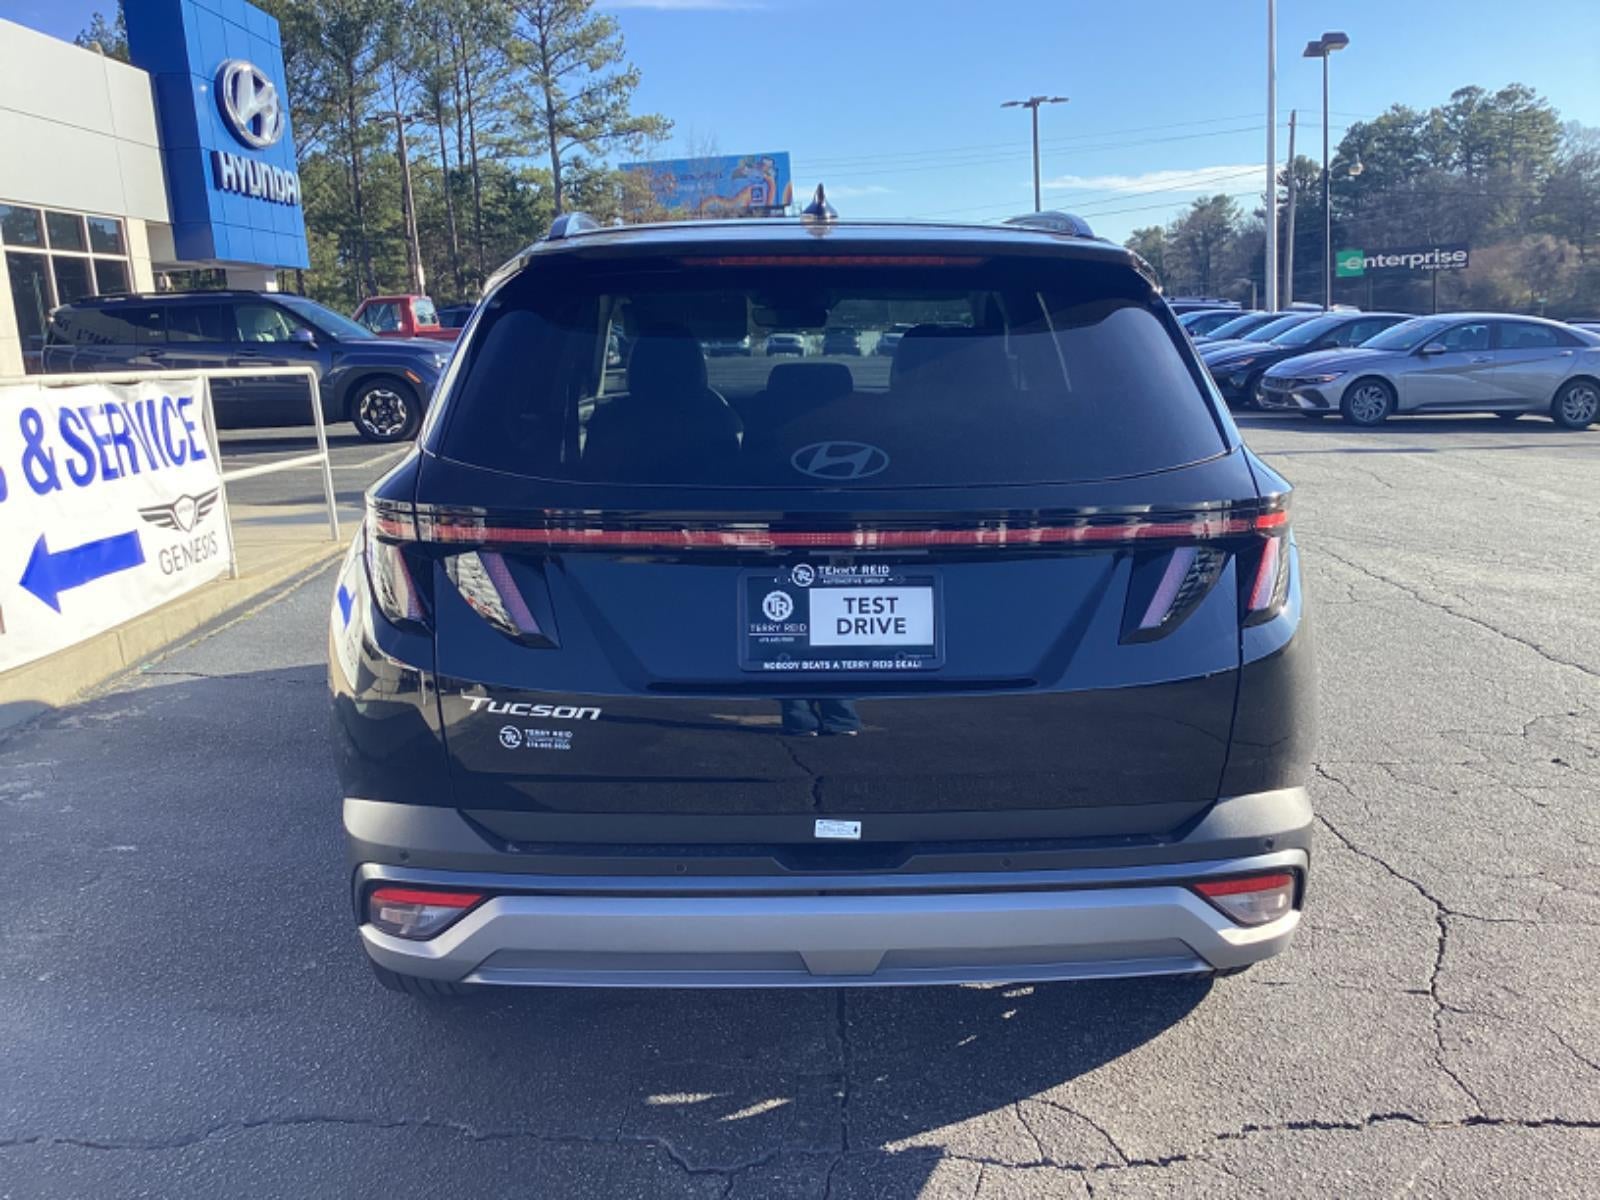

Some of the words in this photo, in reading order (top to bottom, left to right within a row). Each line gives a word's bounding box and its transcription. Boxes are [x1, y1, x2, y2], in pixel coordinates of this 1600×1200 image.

[218, 150, 302, 205] HYUNDAI
[1343, 249, 1468, 269] enterprise
[19, 407, 63, 495] &
[58, 396, 207, 487] SERVICE
[158, 530, 218, 575] GENESIS
[862, 565, 890, 575] REID
[843, 597, 899, 615] TEST
[750, 623, 781, 633] TERRY
[784, 623, 807, 633] REID
[837, 617, 907, 635] DRIVE
[763, 661, 799, 670] NOBODY
[801, 661, 830, 670] BEATS
[833, 661, 840, 669] A
[842, 660, 869, 669] TERRY
[872, 660, 893, 669] REID
